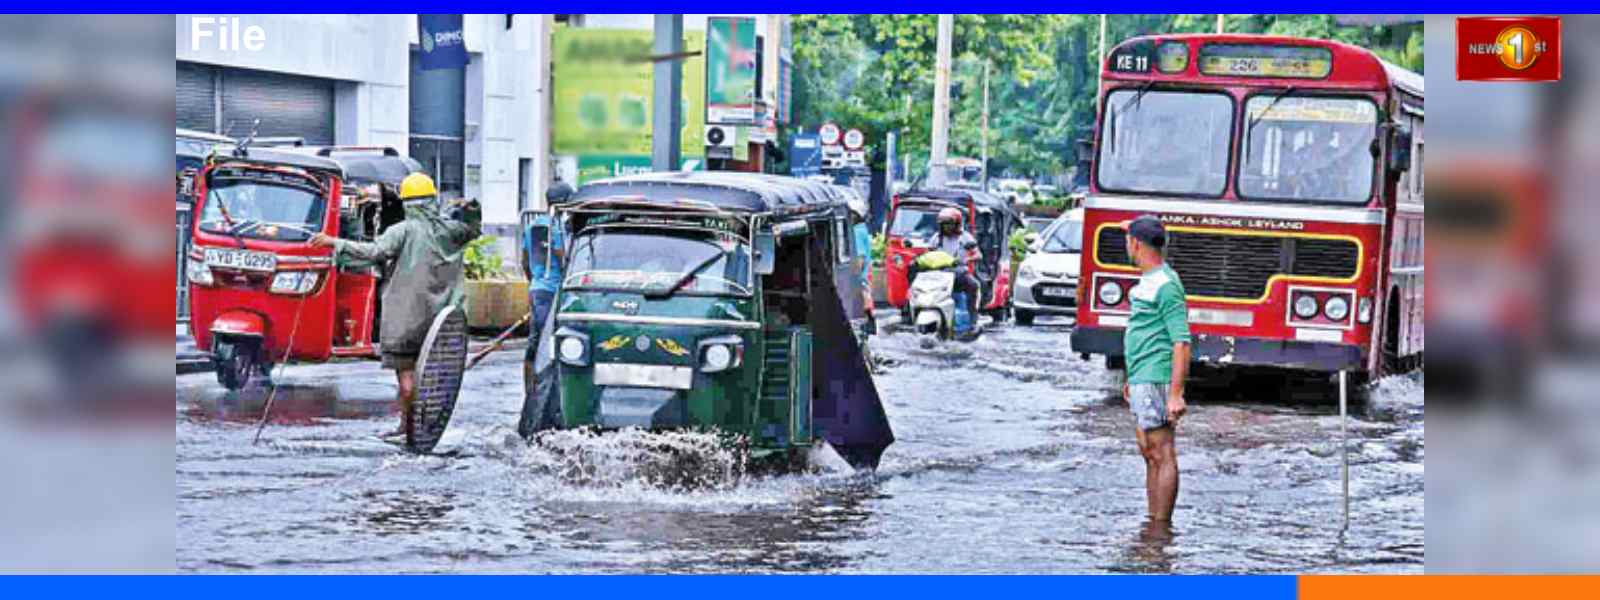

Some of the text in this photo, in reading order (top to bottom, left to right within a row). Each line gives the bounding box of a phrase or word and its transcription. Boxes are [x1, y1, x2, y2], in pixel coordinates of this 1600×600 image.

[1117, 55, 1148, 71] KE 11
[1160, 214, 1195, 224] ANKA
[1247, 220, 1304, 230] LEYLAND
